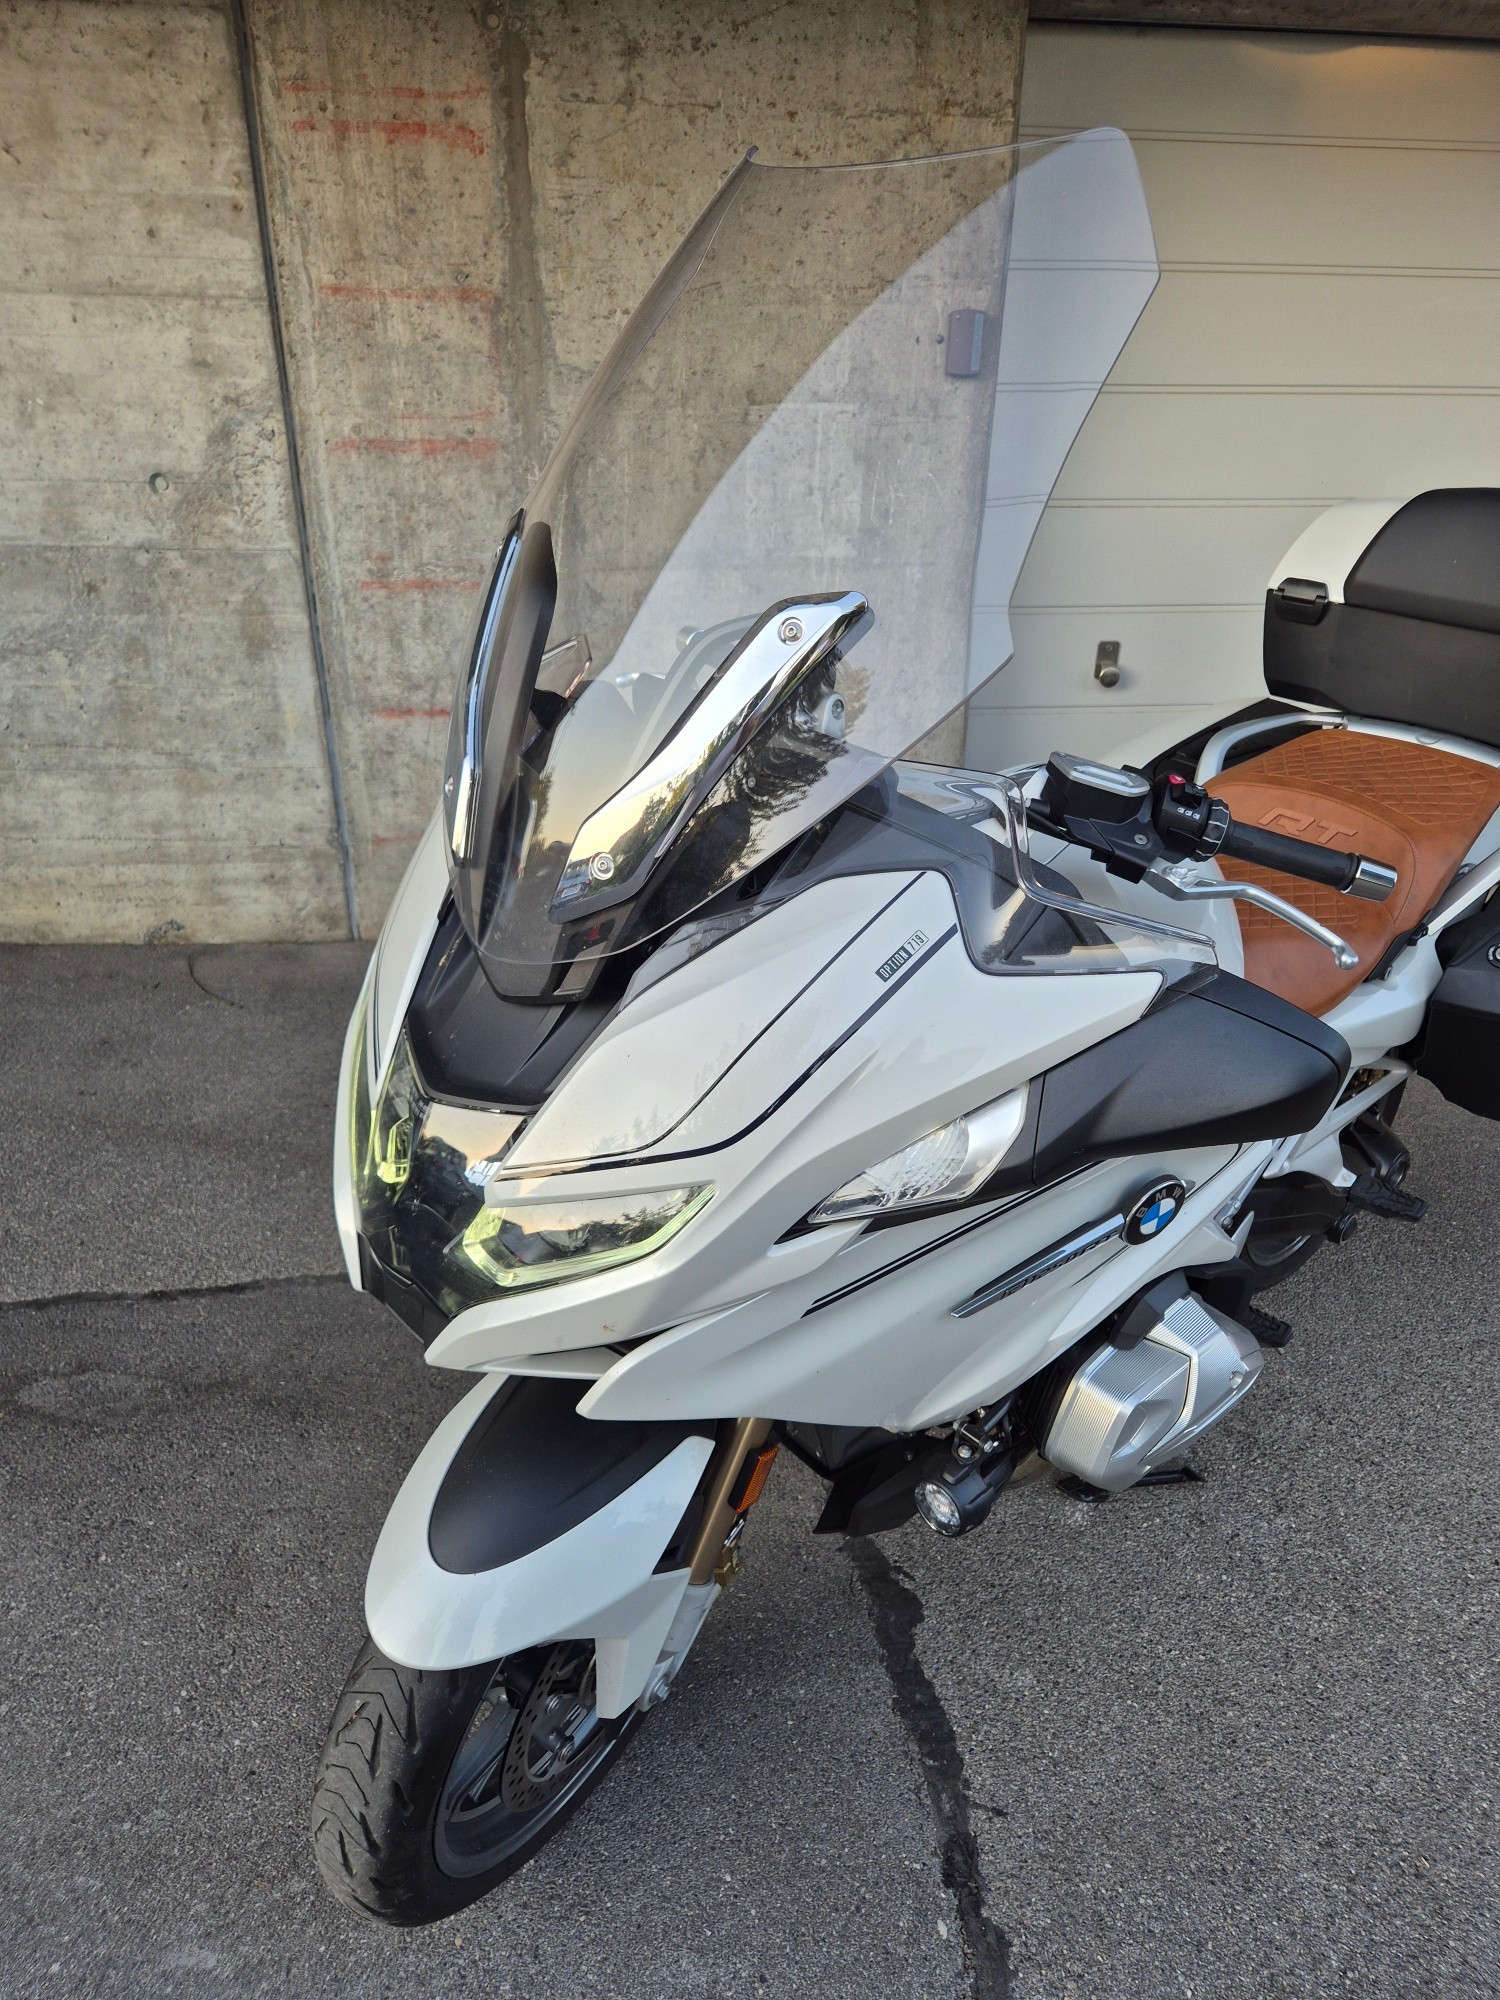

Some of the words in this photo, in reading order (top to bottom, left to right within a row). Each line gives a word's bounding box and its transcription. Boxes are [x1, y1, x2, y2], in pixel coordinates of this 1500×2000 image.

[1257, 807, 1358, 845] RT
[879, 949, 909, 978] OPTION
[907, 934, 925, 952] 719
[1136, 1186, 1183, 1218] BMW
